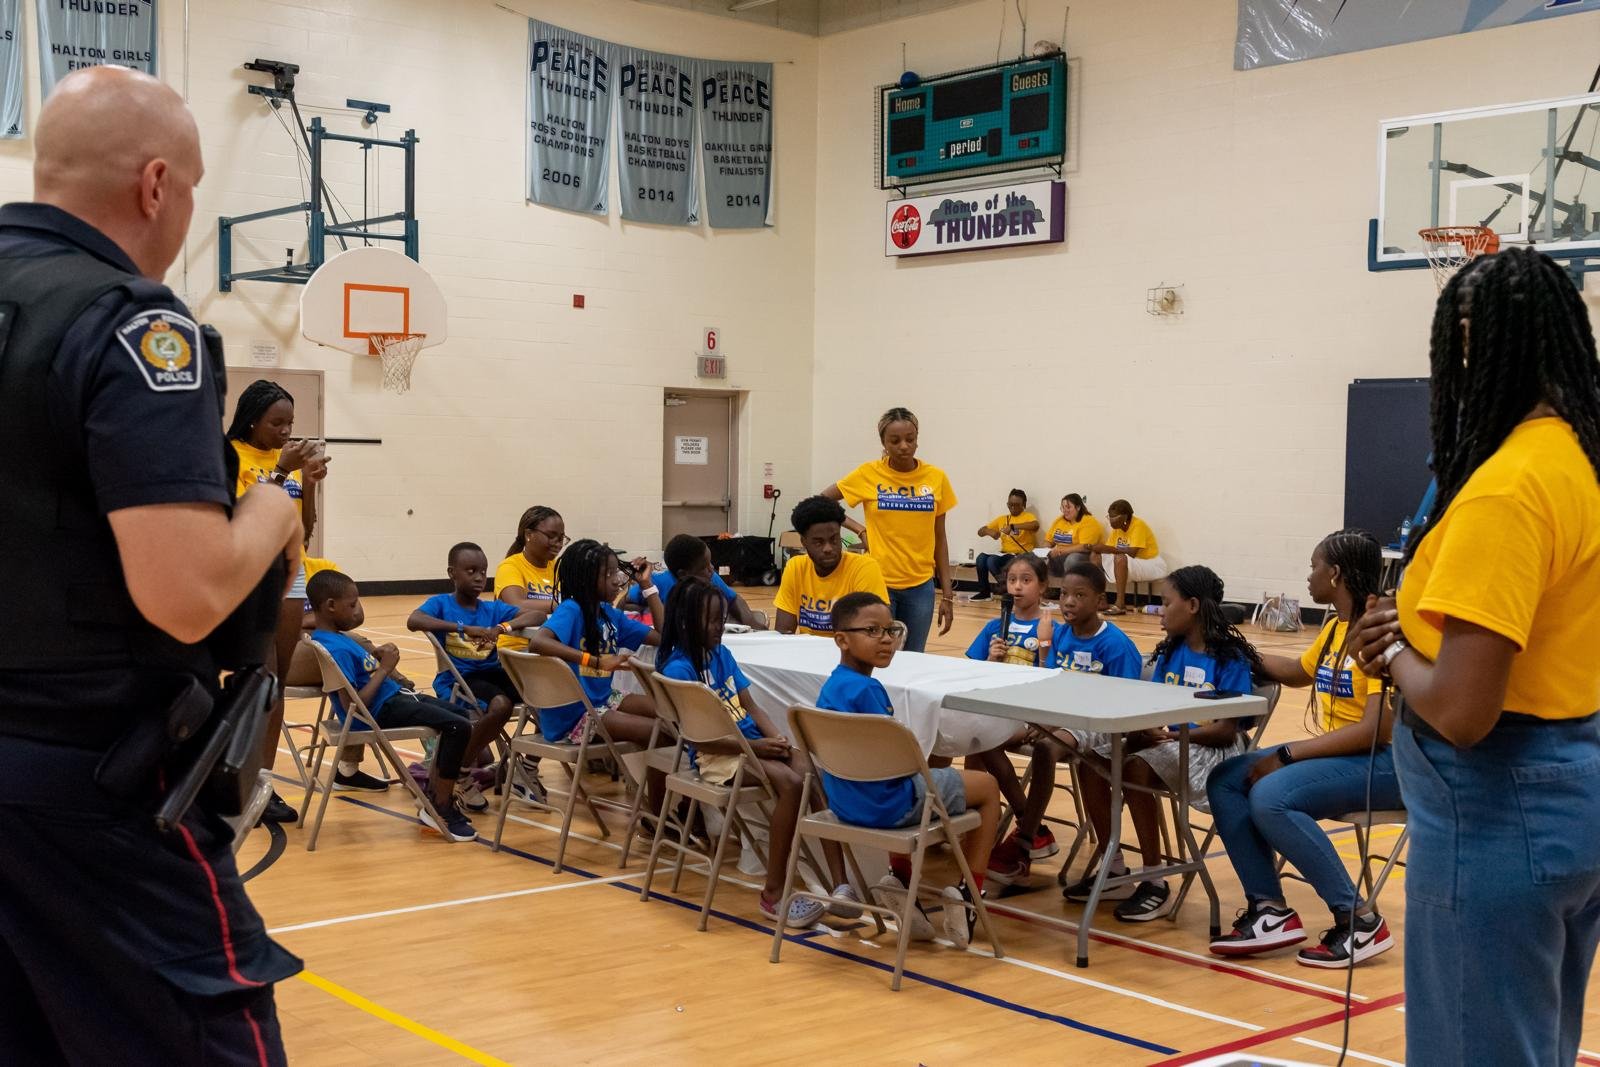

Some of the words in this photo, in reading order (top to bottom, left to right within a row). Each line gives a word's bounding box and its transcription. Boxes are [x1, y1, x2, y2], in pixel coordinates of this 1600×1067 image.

[60, 0, 138, 16] THUNDER
[52, 43, 106, 59] HALTON
[113, 49, 151, 62] GIRLS
[530, 40, 608, 94] PEACE
[540, 75, 597, 102] THUNDER
[620, 64, 693, 108] PEACE
[1012, 71, 1048, 92] Guests
[702, 77, 770, 111] PEACE
[628, 99, 683, 117] THUNDER
[895, 96, 921, 113] Home
[546, 113, 585, 131] HALTON
[712, 111, 763, 123] THUNDER
[531, 121, 557, 136] ROSS
[560, 129, 605, 148] COUNTRY
[624, 131, 661, 145] HALTON
[665, 137, 690, 149] BOYS
[534, 134, 595, 158] CHAMPIONS
[627, 144, 687, 161] BASKETBALL
[704, 142, 746, 152] OAKVILLE
[950, 136, 982, 158] period
[628, 156, 686, 172] CHAMPIONS
[713, 155, 769, 164] BASKETBALL
[542, 168, 581, 188] 2006
[719, 167, 764, 176] FINALISTS
[638, 187, 674, 203] 2014
[726, 194, 760, 207] 2014
[944, 199, 977, 216] Home
[985, 193, 999, 210] of
[1005, 191, 1027, 208] the
[933, 210, 1036, 245] THUNDER
[707, 331, 716, 350] 6
[704, 359, 721, 375] EXIT
[155, 371, 194, 383] POLICE
